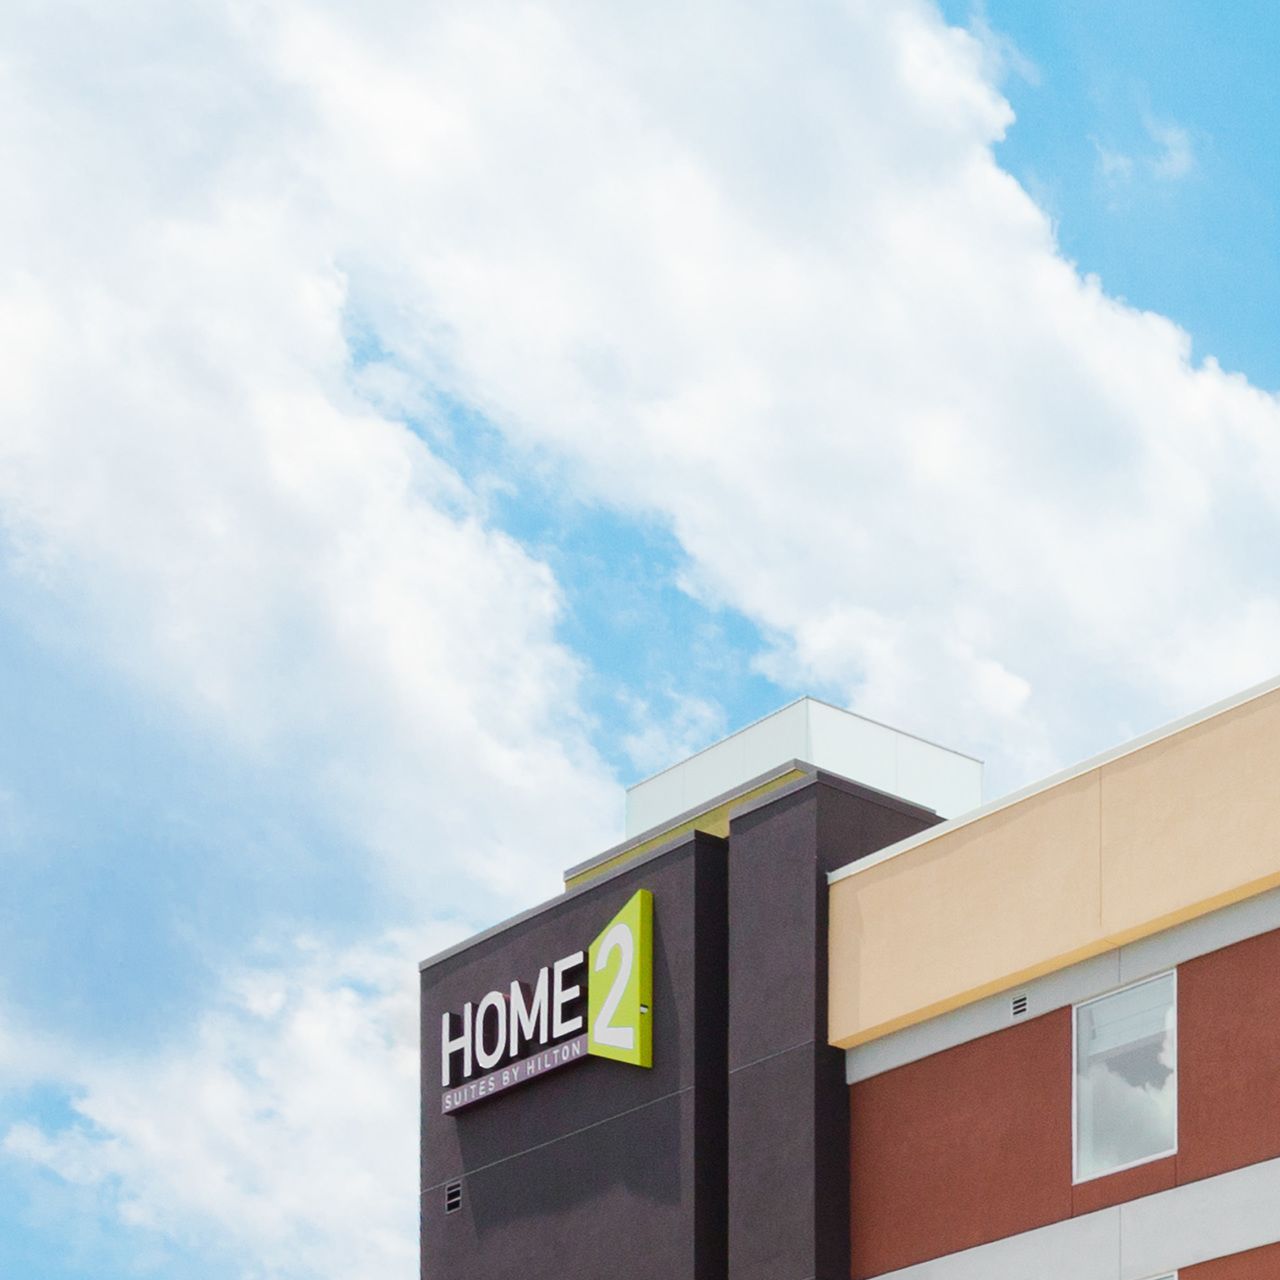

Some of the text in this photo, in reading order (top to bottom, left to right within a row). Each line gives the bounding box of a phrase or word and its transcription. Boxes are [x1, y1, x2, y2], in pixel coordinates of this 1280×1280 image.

[444, 1041, 581, 1110] SUITES BY HILTON
